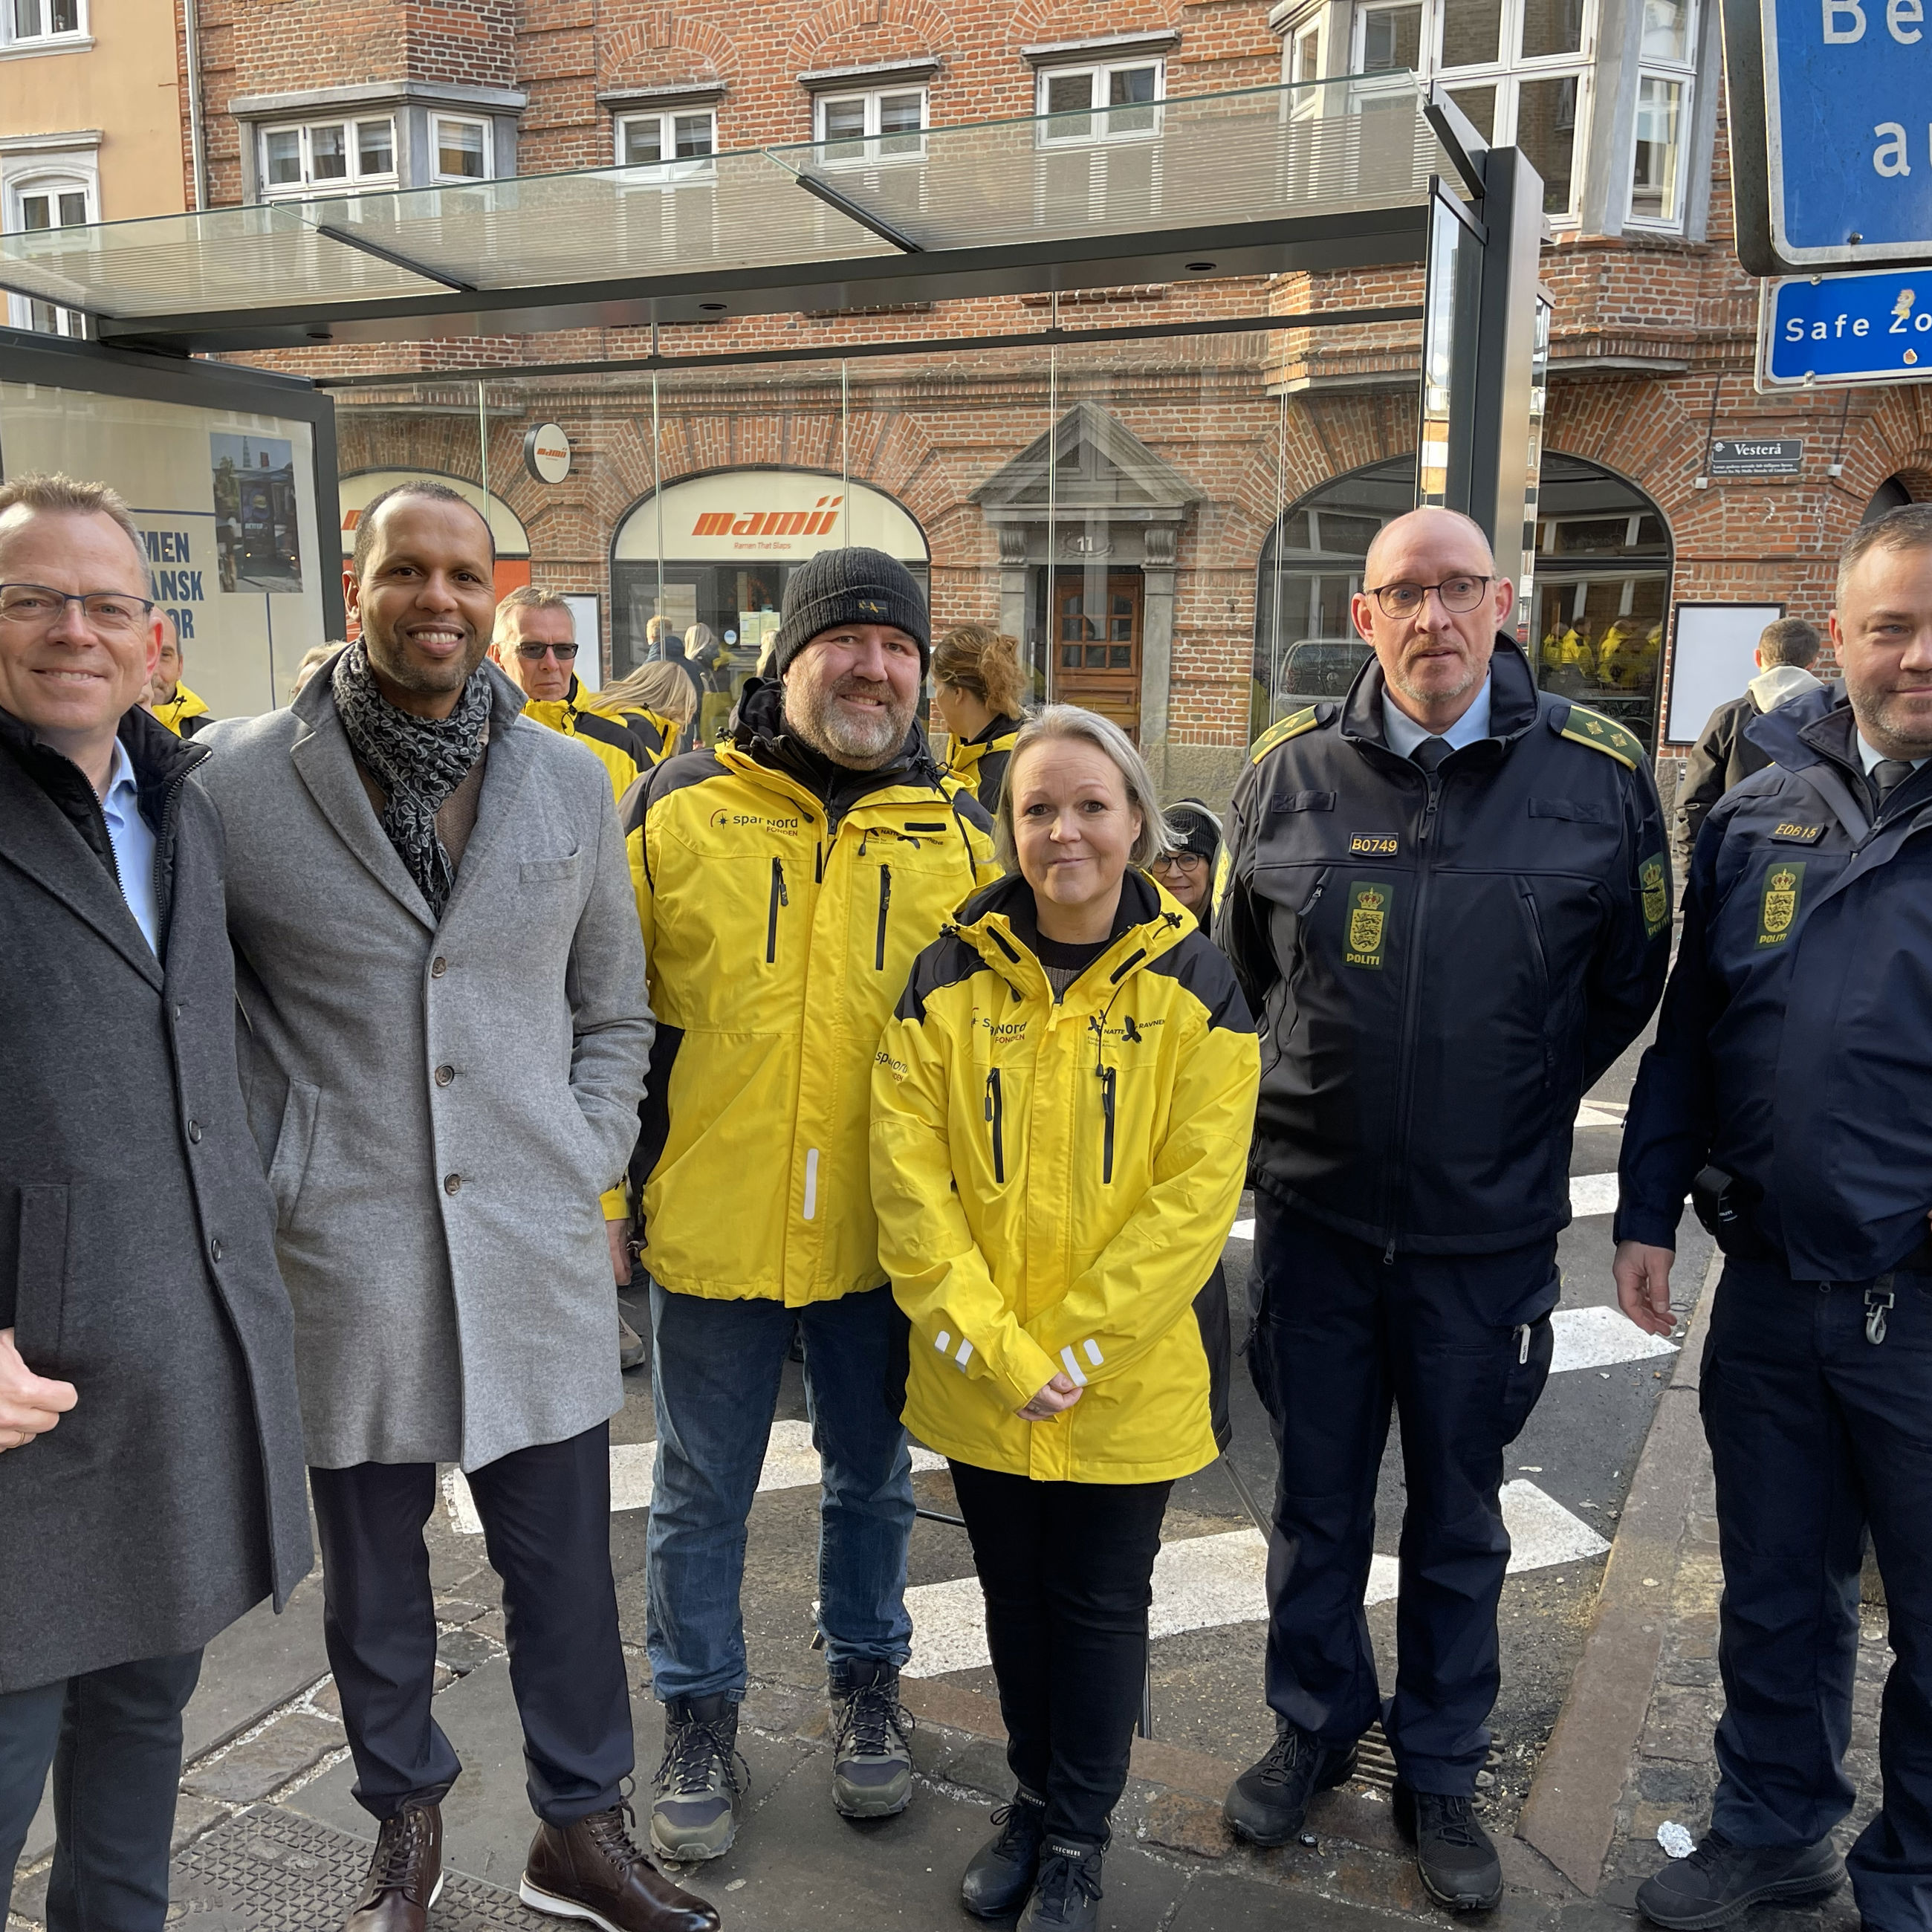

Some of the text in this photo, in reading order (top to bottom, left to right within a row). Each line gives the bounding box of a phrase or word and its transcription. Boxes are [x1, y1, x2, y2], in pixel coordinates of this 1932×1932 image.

[1785, 314, 1870, 343] Safe
[1734, 443, 1781, 456] Vesterå
[691, 495, 844, 536] mamii
[773, 542, 791, 551] Slaps
[1077, 536, 1093, 551] 11
[1352, 838, 1398, 852] B0749
[1346, 953, 1380, 965] POLITI
[1052, 1845, 1080, 1856] SKECHERS
